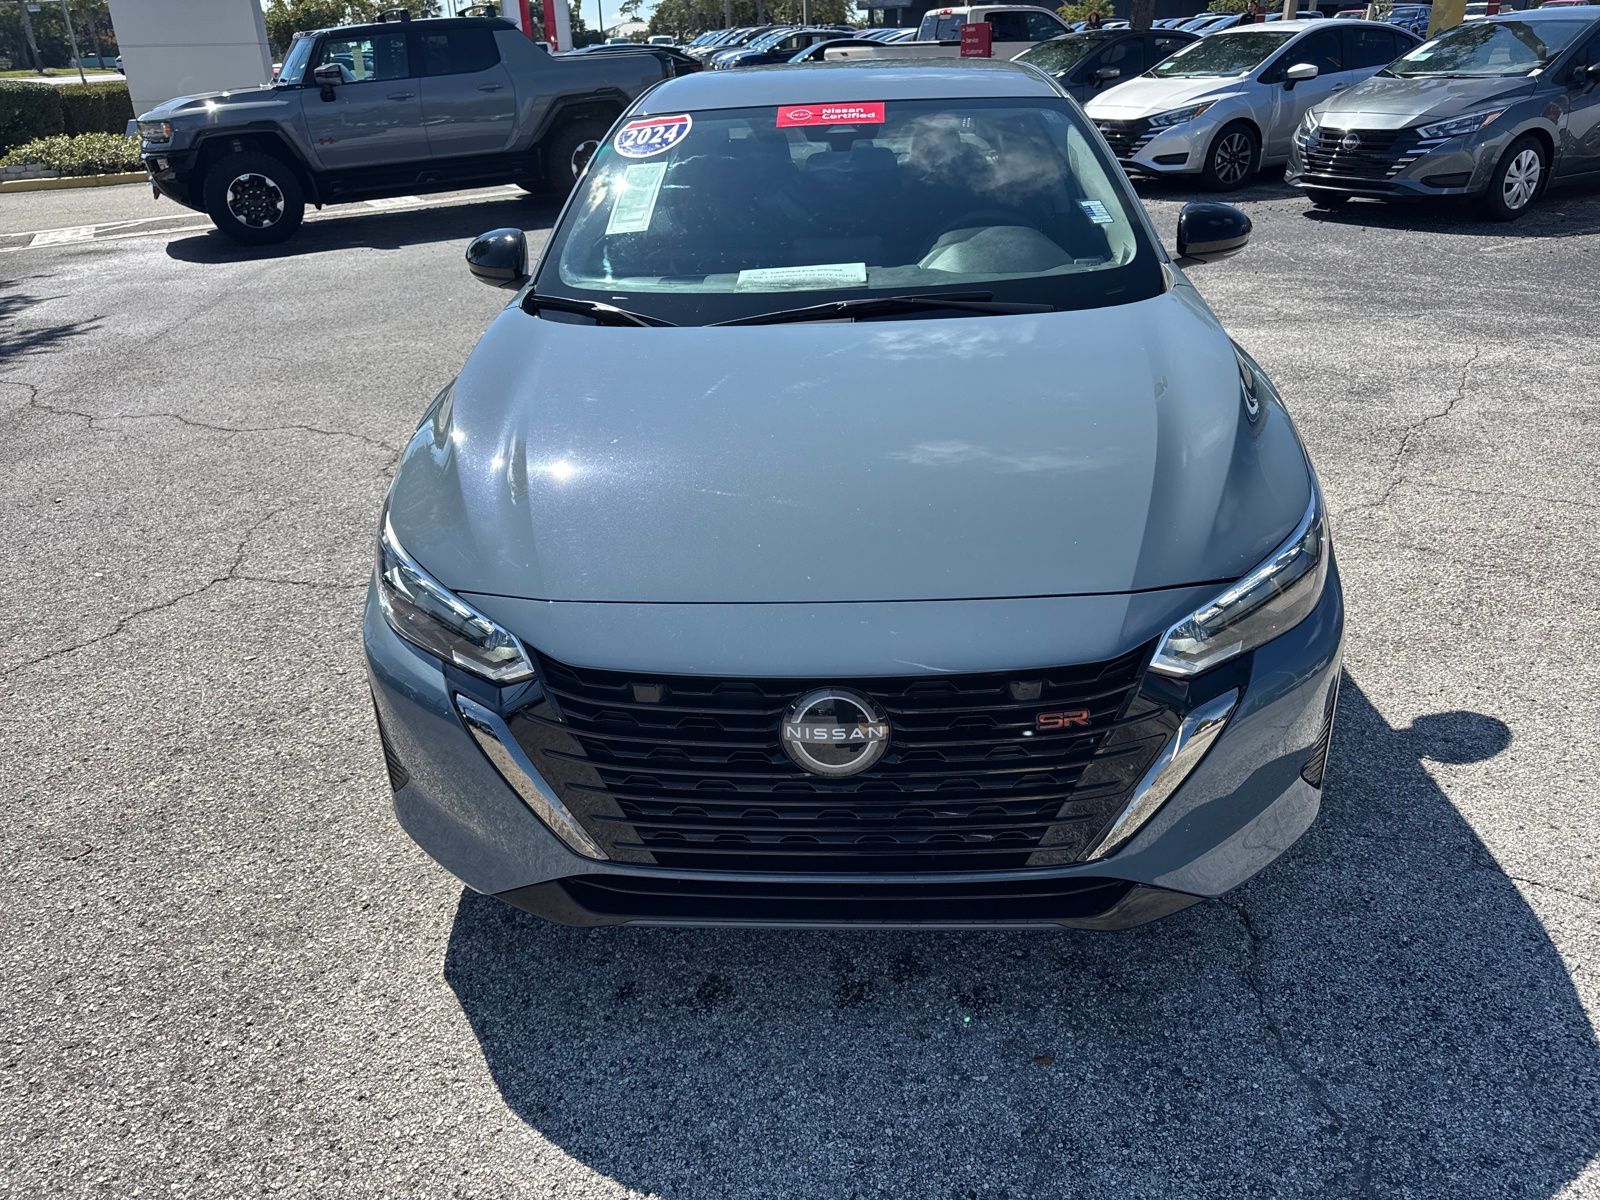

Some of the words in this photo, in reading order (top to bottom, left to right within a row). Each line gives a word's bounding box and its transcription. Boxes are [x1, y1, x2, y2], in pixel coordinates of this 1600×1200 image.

[821, 112, 876, 120] Certified
[621, 124, 680, 147] 2024
[1036, 709, 1090, 730] SR
[786, 725, 884, 741] NISSAN
